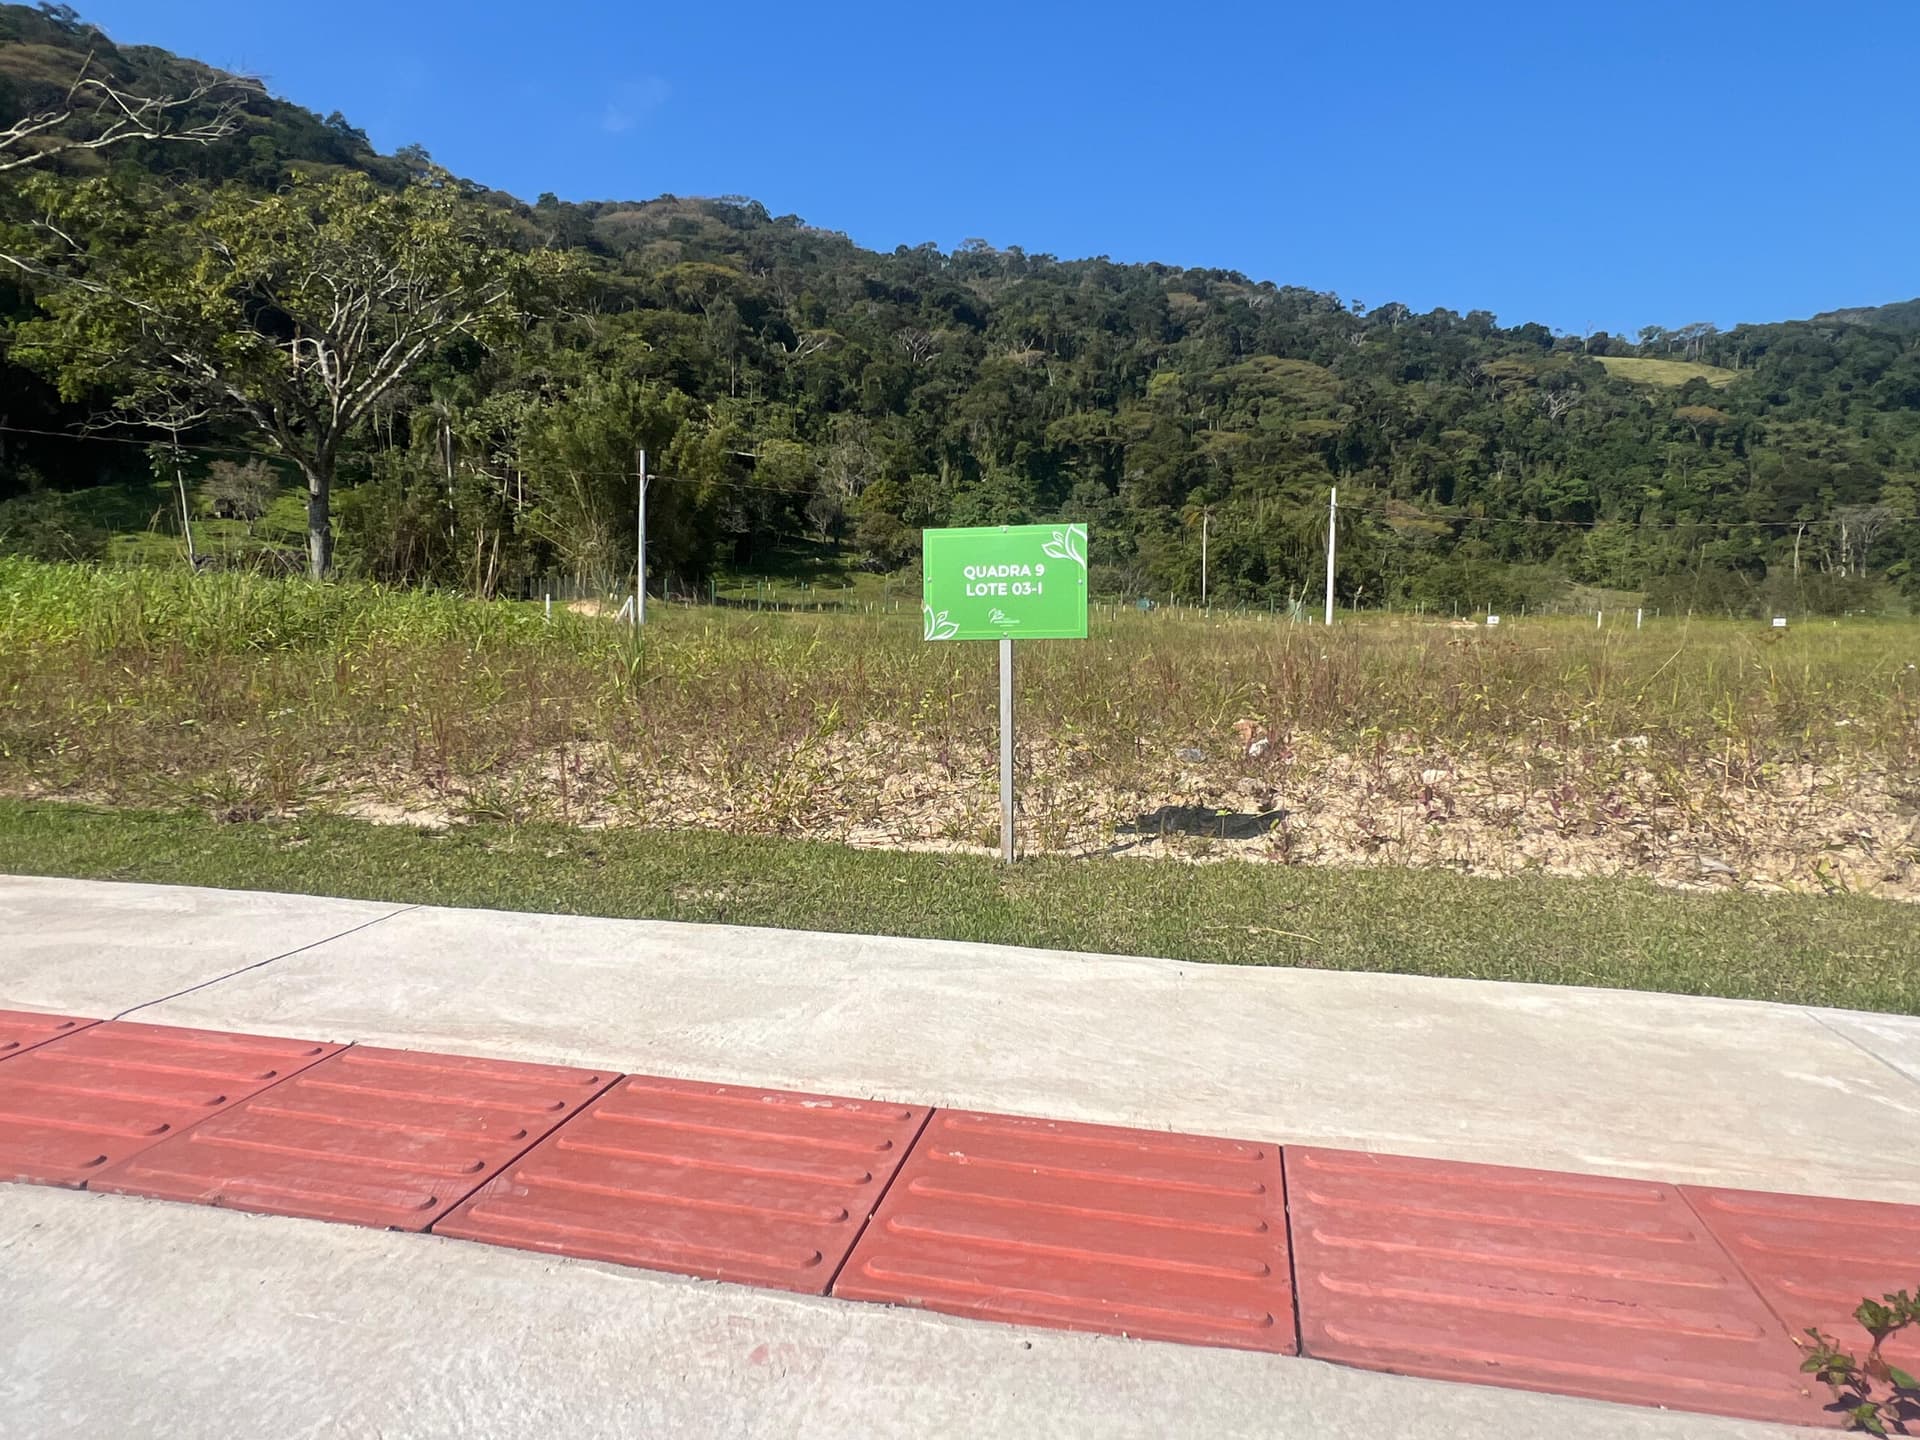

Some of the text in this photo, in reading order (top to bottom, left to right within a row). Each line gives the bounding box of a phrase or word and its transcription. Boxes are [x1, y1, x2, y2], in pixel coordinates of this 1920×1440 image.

[963, 563, 1046, 581] QUADRA 9
[966, 583, 1008, 597] LOTE
